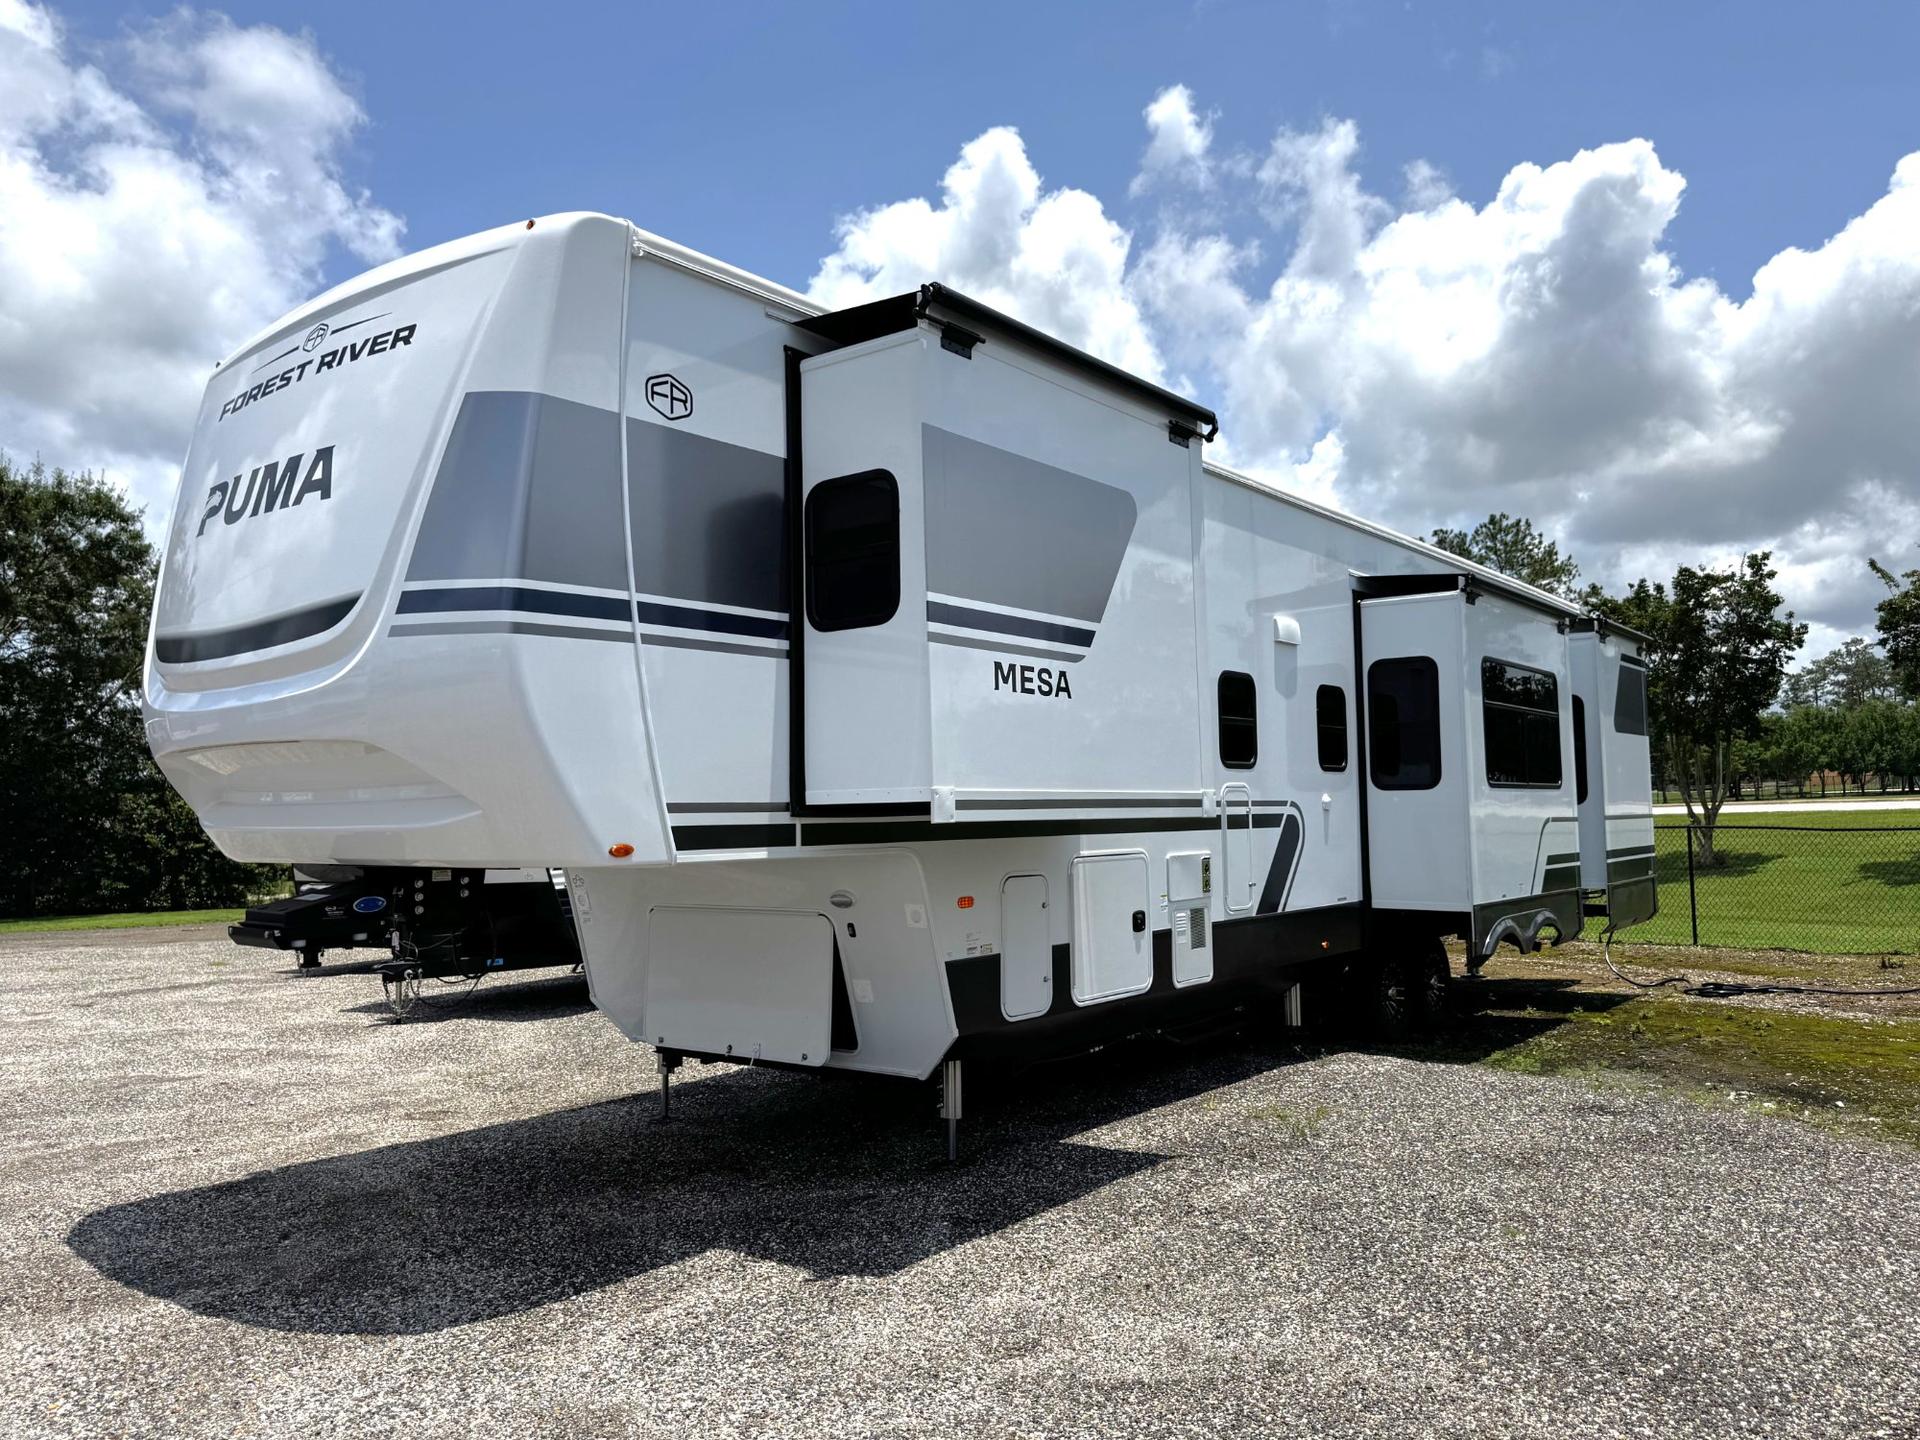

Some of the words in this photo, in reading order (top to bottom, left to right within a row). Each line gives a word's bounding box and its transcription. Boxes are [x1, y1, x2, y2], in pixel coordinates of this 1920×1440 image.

[218, 358, 314, 423] FOREST
[315, 323, 417, 375] RIVER
[650, 379, 689, 415] FR
[196, 444, 336, 538] PUMA
[994, 661, 1072, 699] MESA
